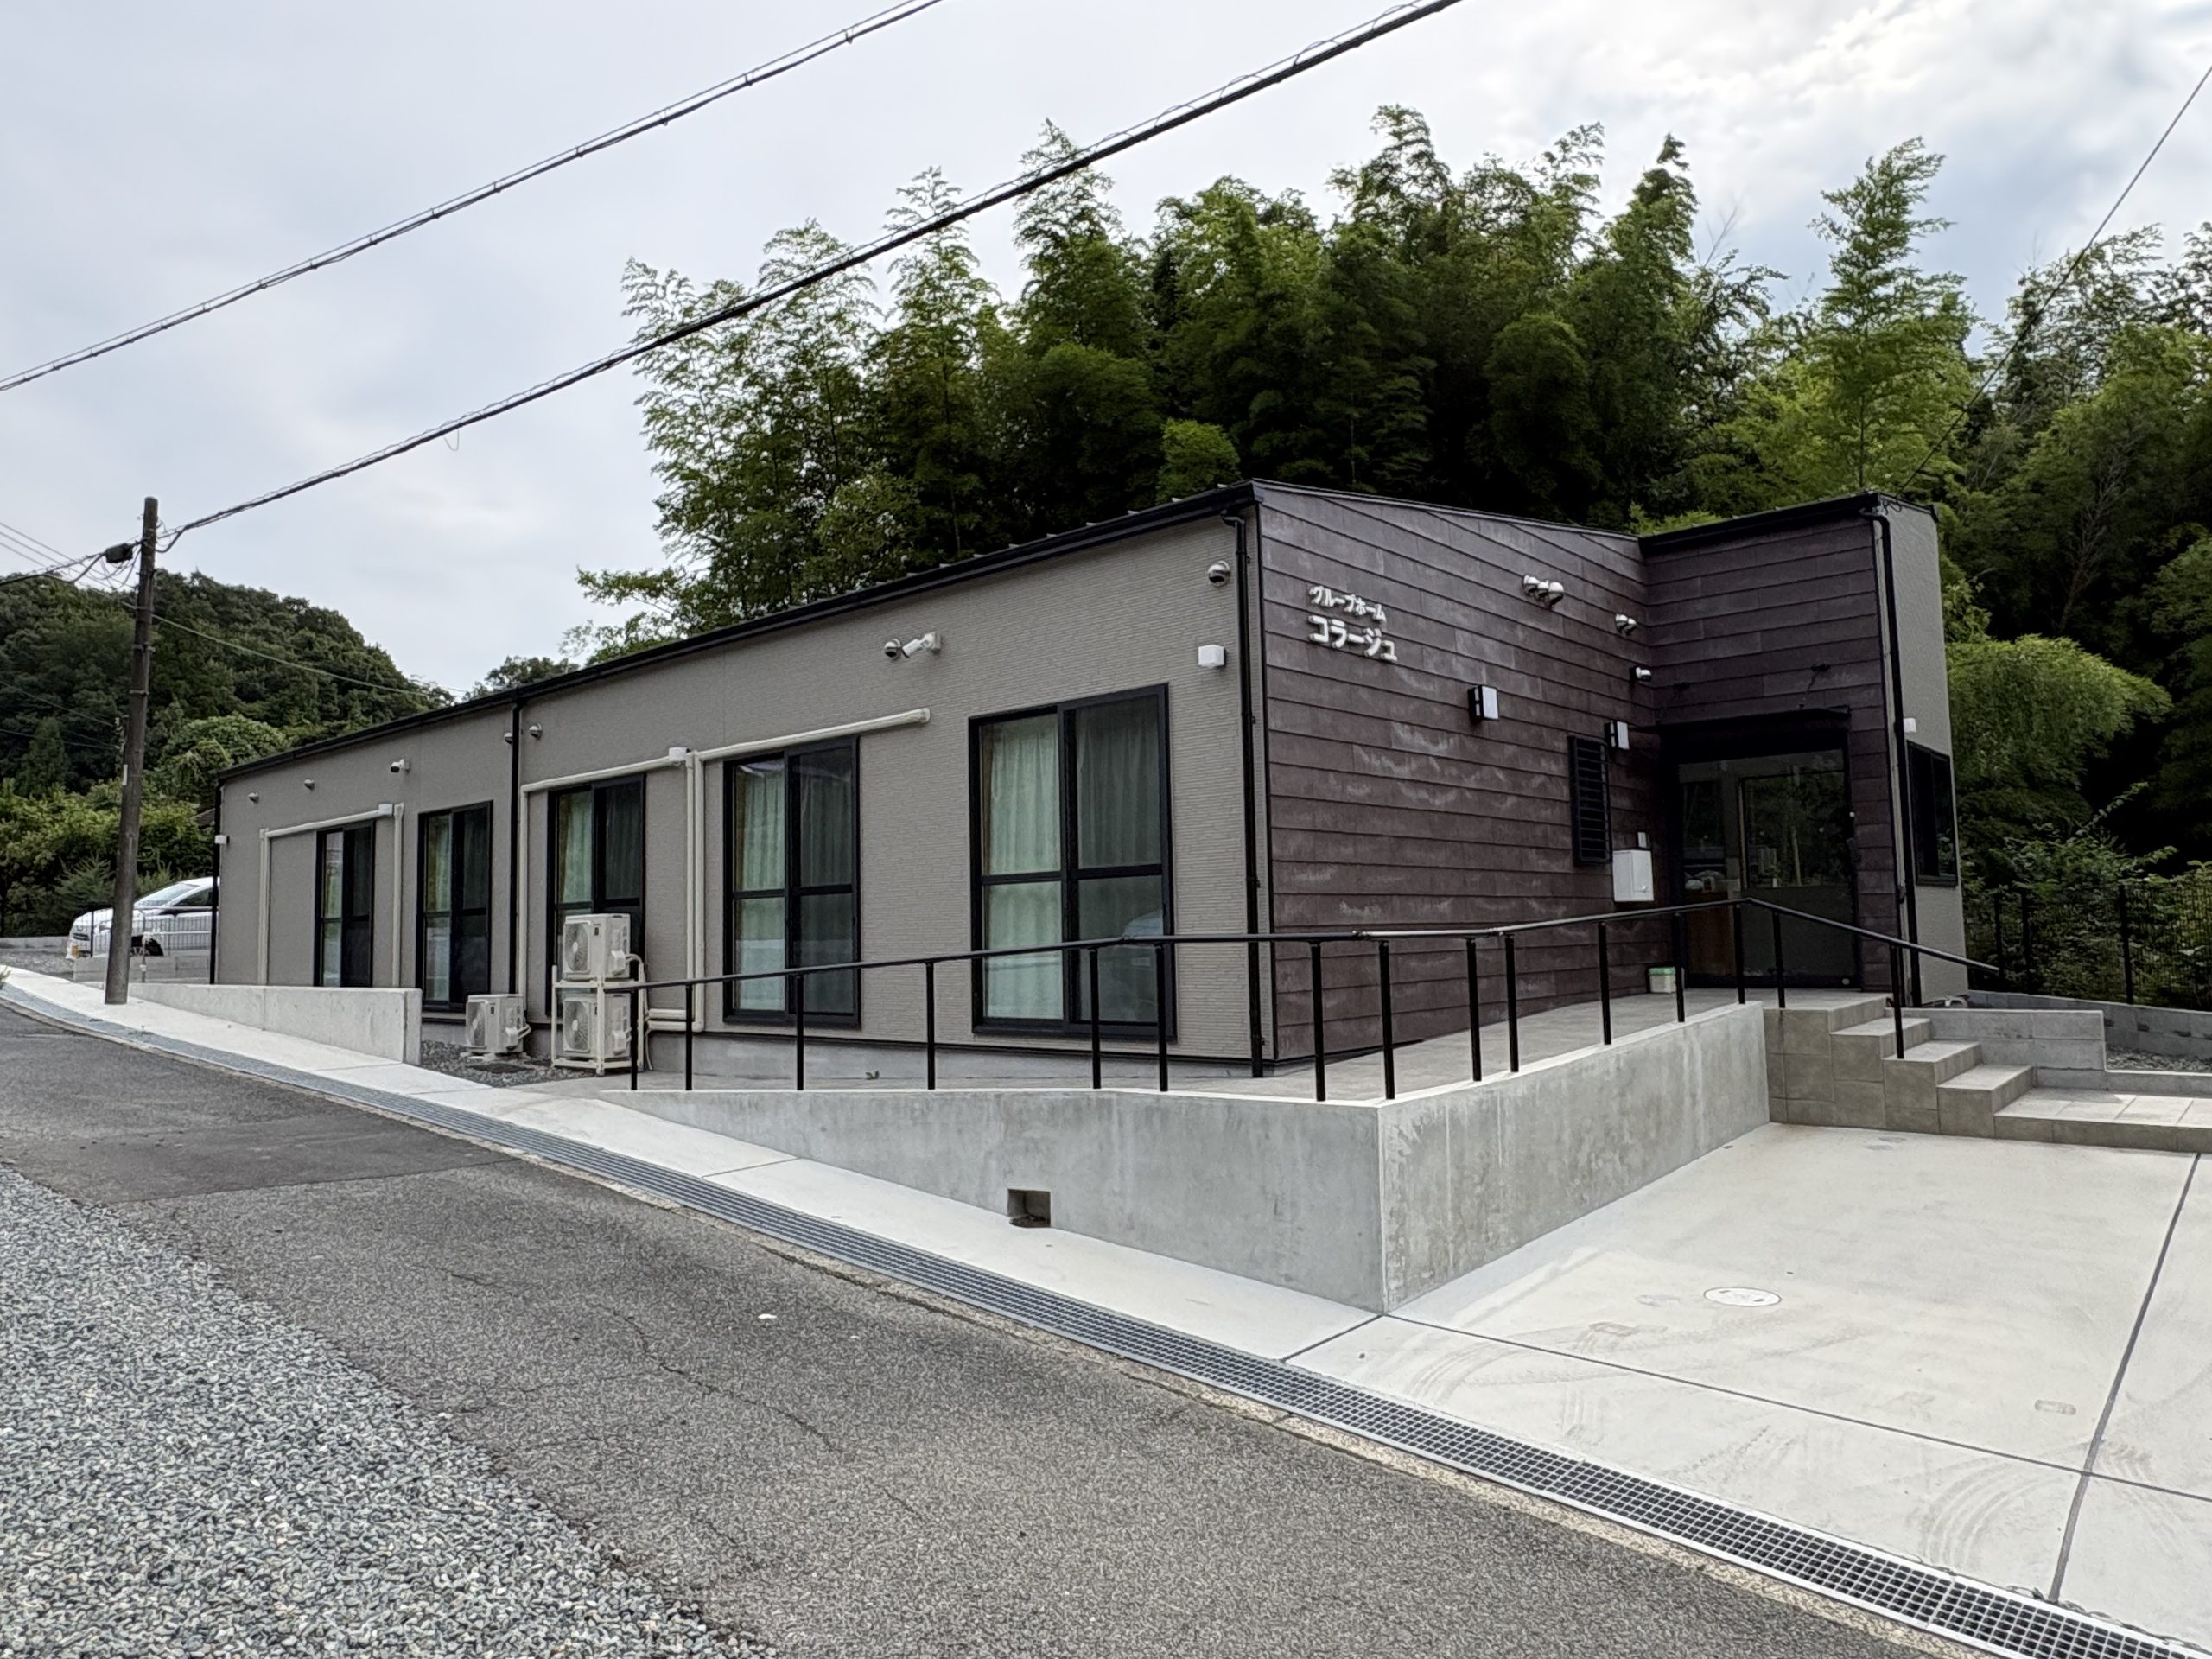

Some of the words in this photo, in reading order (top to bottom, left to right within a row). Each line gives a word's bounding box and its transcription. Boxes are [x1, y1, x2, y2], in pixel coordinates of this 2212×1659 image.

[1308, 615, 1398, 661] コラージュ
